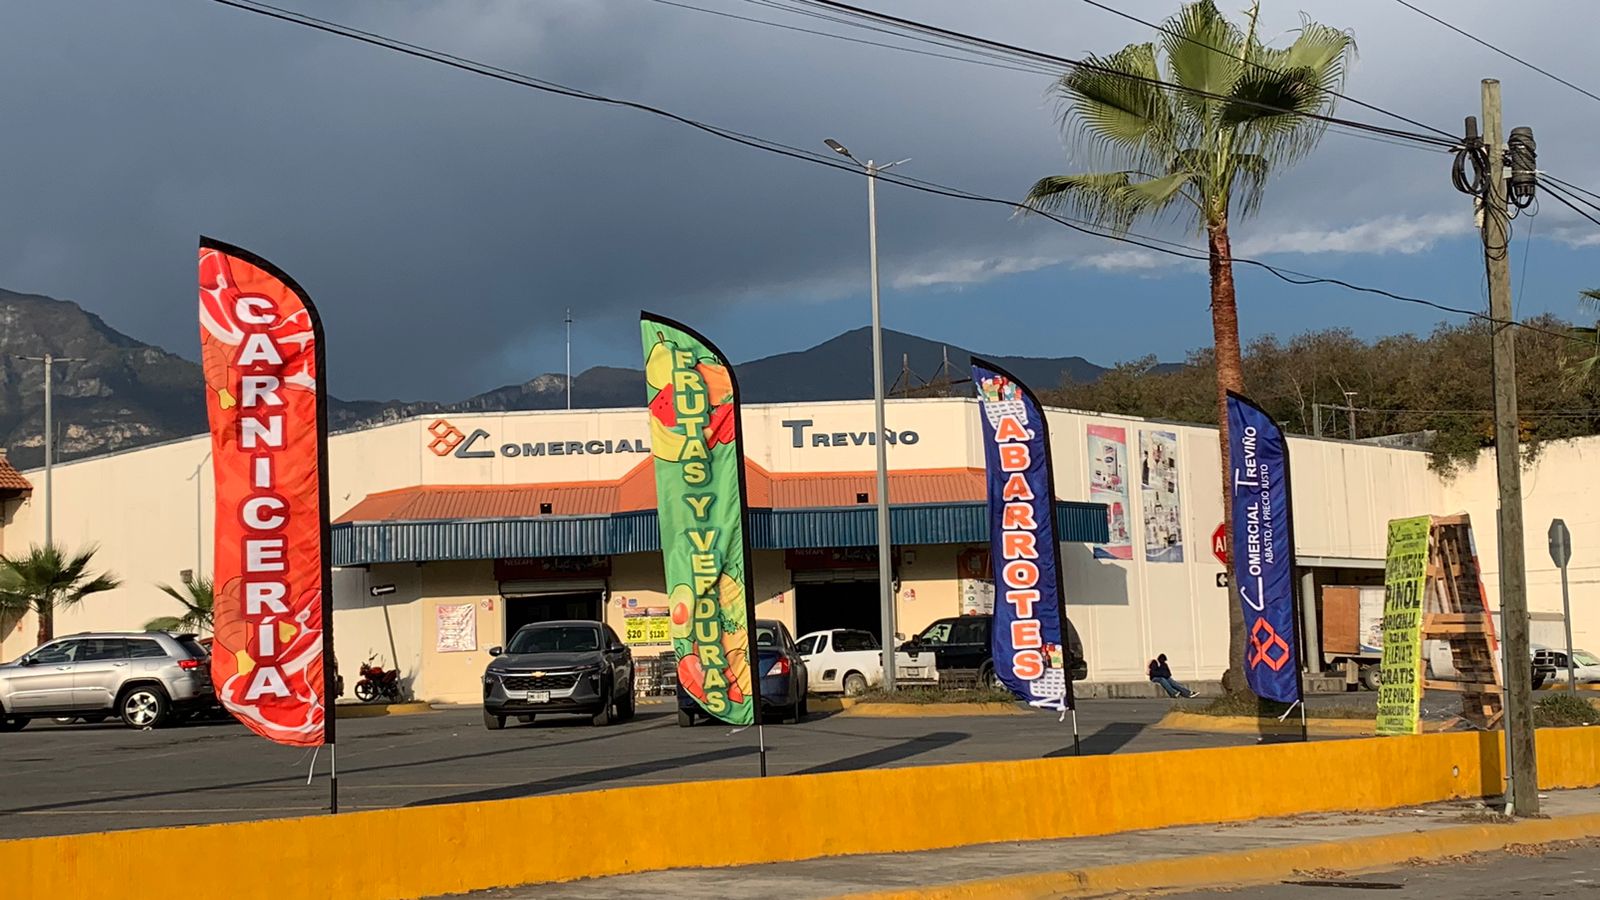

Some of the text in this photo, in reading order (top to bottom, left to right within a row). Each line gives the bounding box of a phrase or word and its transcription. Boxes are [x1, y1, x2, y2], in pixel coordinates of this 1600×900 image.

[454, 428, 651, 458] COMERCIAL
[1260, 464, 1270, 490] JUSTO
[234, 296, 293, 701] CARNICERÍA
[1261, 491, 1272, 521] PRECIO
[674, 351, 726, 713] FRUTAS Y VERDURAS
[1234, 426, 1265, 612] COMERCIAL TREVIÑO
[994, 413, 1045, 681] ABARROTES
[1385, 580, 1420, 612] PINOL
[626, 629, 642, 640] $20
[649, 630, 665, 639] $120
[1380, 668, 1415, 685] GRATIS
[1393, 687, 1415, 704] PINOL
